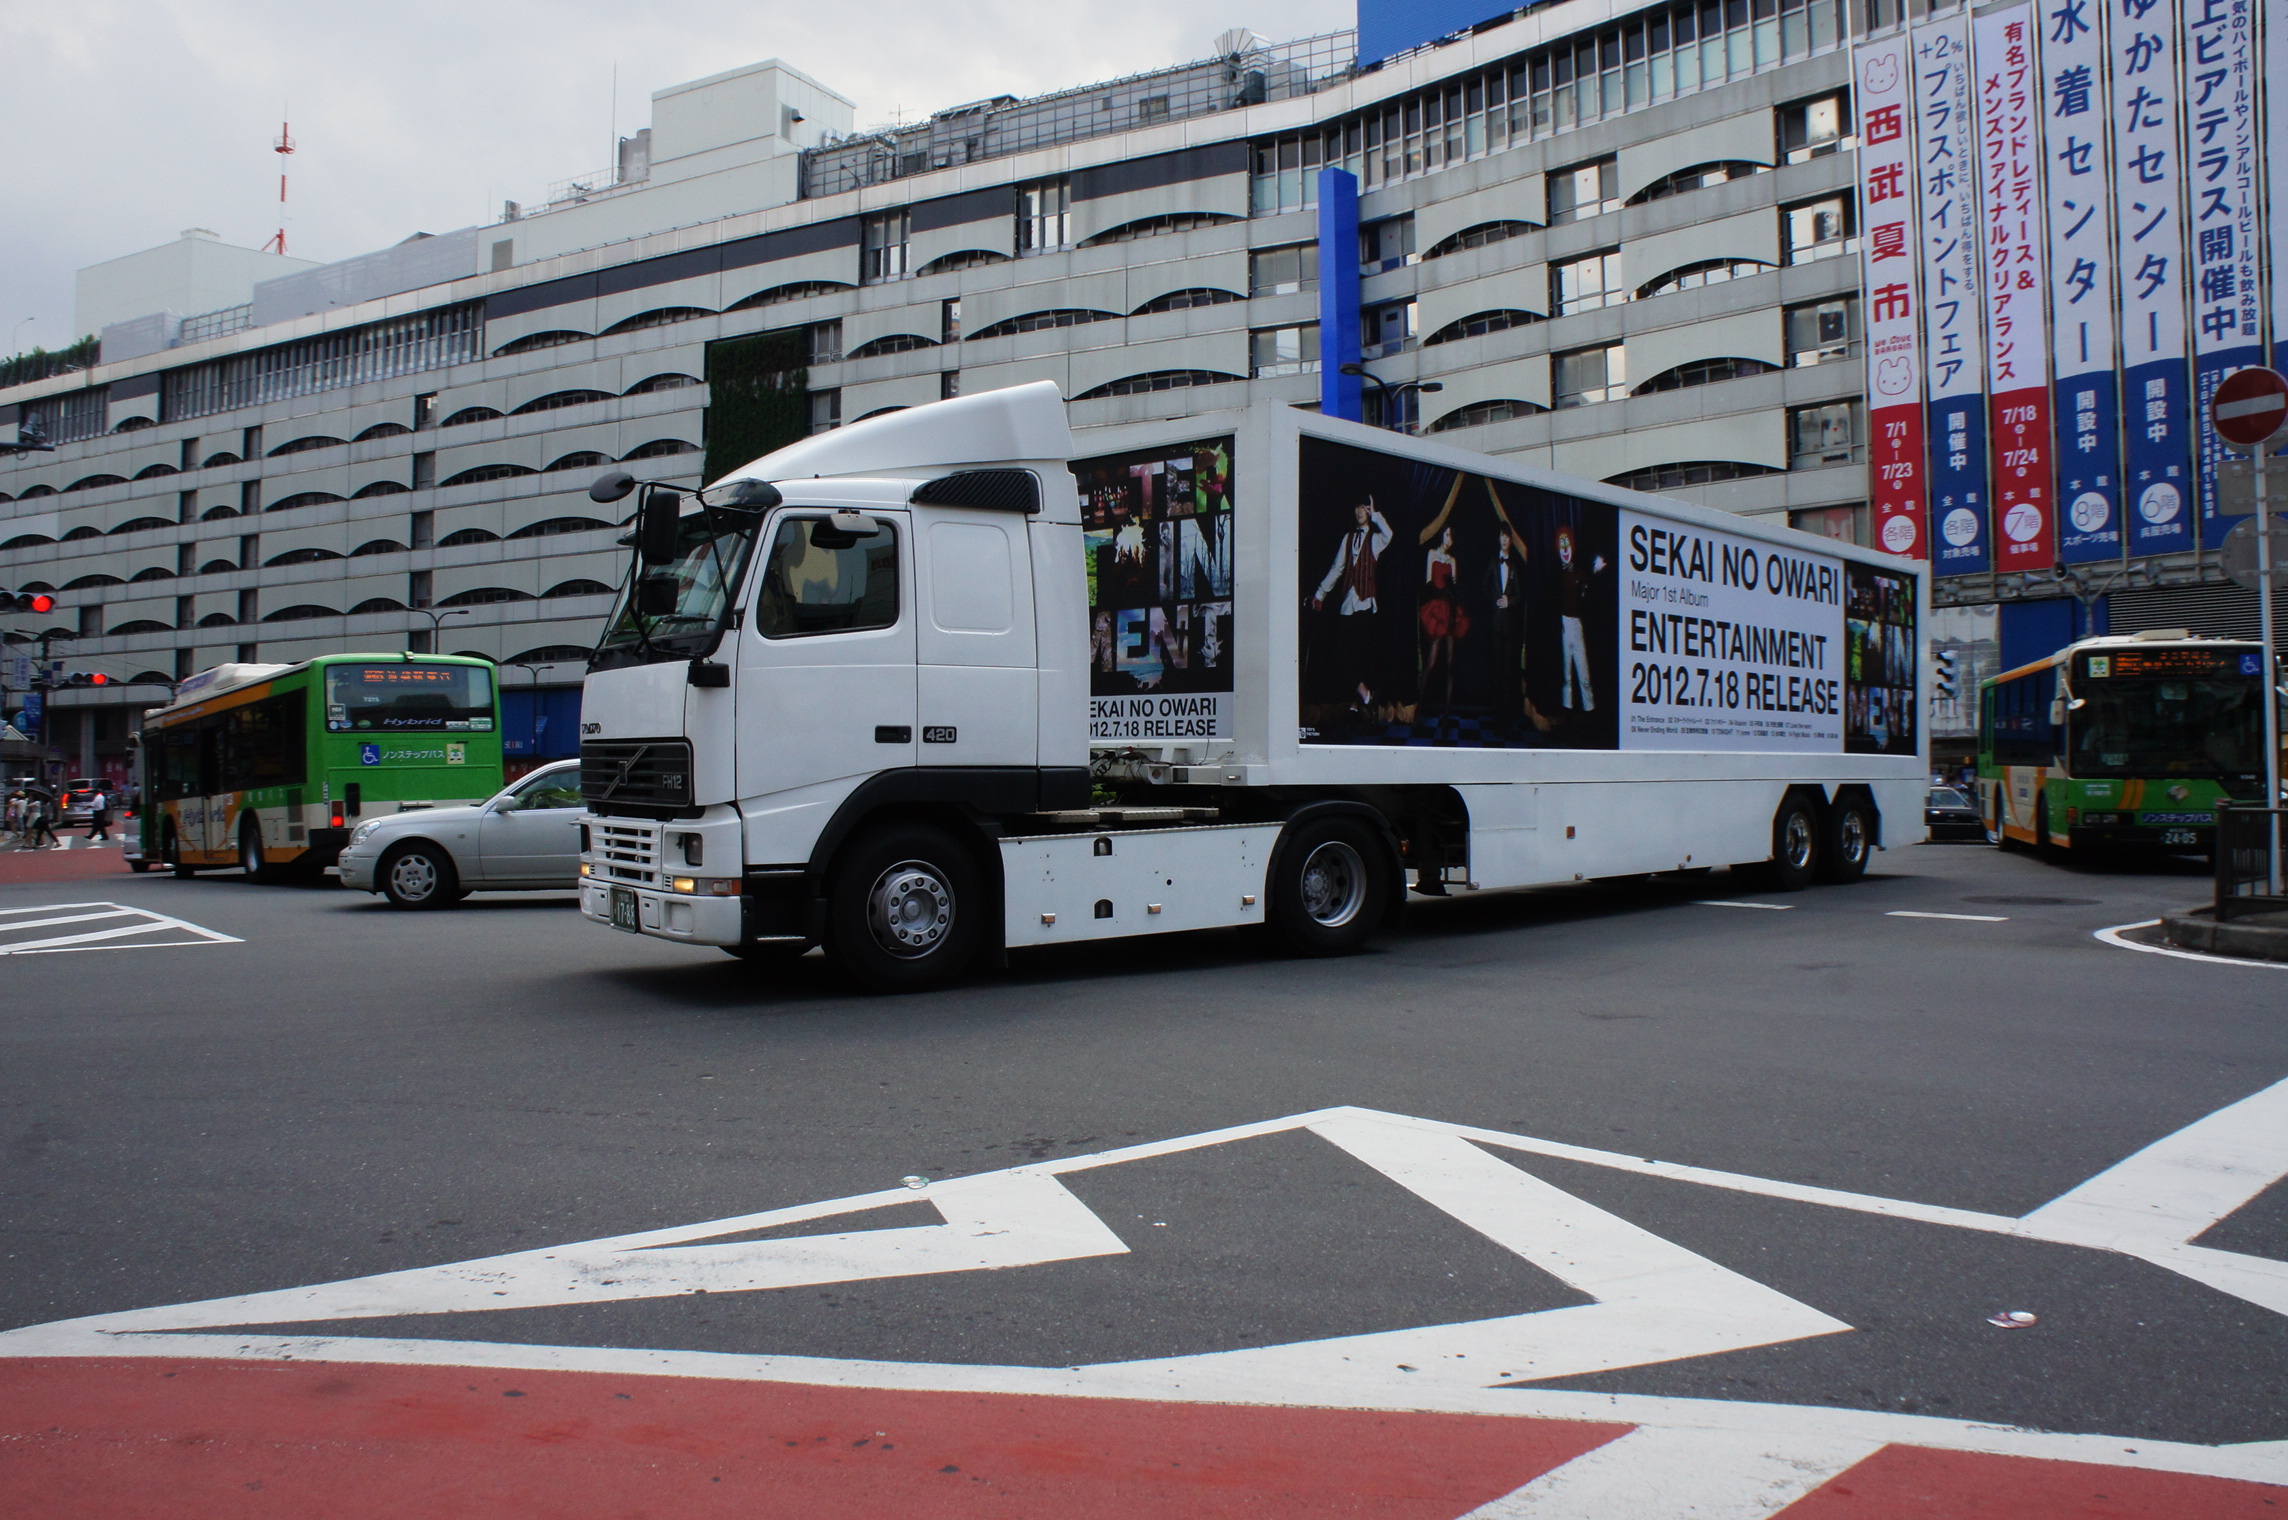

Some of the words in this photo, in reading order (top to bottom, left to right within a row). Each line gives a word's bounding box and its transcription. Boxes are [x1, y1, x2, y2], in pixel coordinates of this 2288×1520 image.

[1864, 103, 1911, 324] 西武夏市
[2002, 405, 2037, 425] 7/18
[2145, 378, 2168, 443] 開設中
[1885, 421, 1908, 438] 7/1
[2076, 390, 2097, 453] 開設中
[1947, 411, 1968, 471] 開催中
[2003, 448, 2039, 467] 7/24
[1881, 462, 1913, 480] 7/23
[1629, 524, 1713, 583] SEKAI
[1722, 543, 1759, 591] NO
[1766, 553, 1839, 606] OWARI
[1631, 580, 1659, 603] Major
[1663, 585, 1677, 603] 1st
[1679, 587, 1709, 608] Album
[1631, 609, 1827, 670] ENTERTAINMENT
[1631, 662, 1739, 709] 2012.7.18
[1746, 671, 1839, 715] RELEASE
[1129, 698, 1155, 717] NO
[1159, 697, 1216, 717] OWARI
[383, 718, 442, 726] Hybrid
[1090, 720, 1140, 737] 12.7.18
[1144, 719, 1216, 737] RELEASE
[925, 728, 955, 742] 420
[382, 749, 445, 759] ノンステップバス
[662, 774, 683, 790] FH12
[2143, 812, 2214, 822] ノンステップバス
